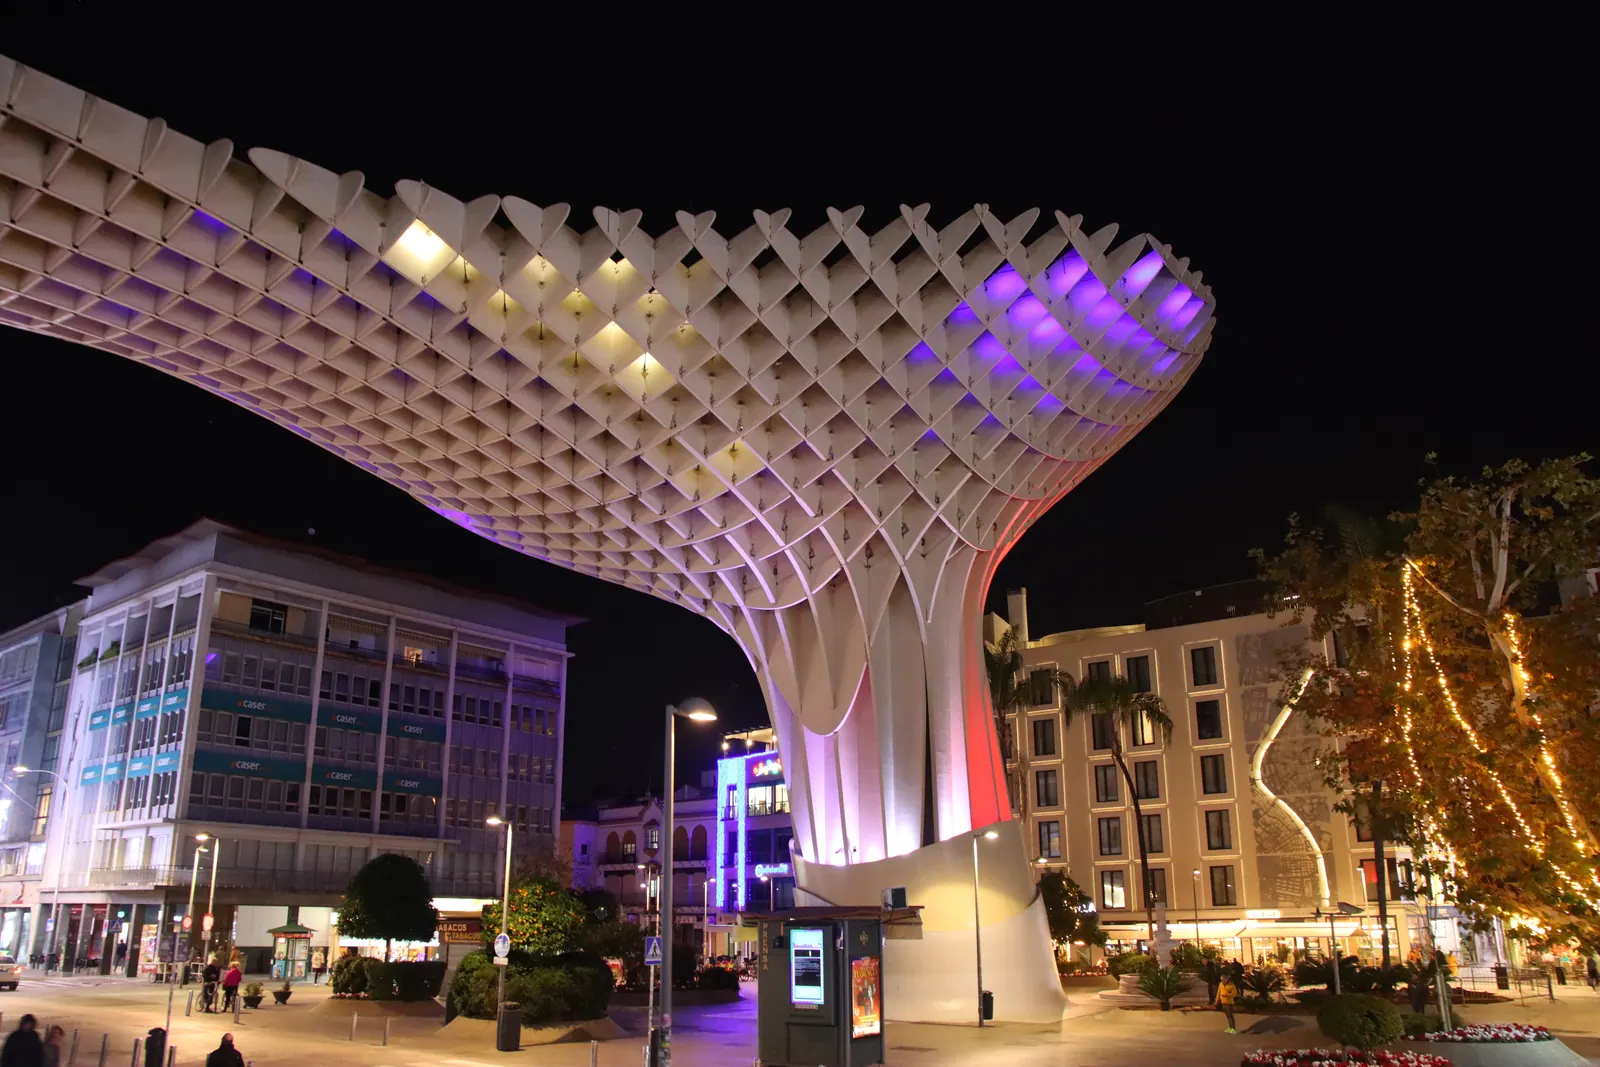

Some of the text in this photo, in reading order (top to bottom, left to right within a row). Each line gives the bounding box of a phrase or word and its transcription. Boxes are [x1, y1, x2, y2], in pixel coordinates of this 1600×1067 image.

[243, 700, 267, 710] caser
[336, 714, 357, 724] caser
[404, 725, 424, 734] caser
[236, 760, 260, 771] caser
[331, 771, 352, 781] caser
[400, 780, 420, 789] caser
